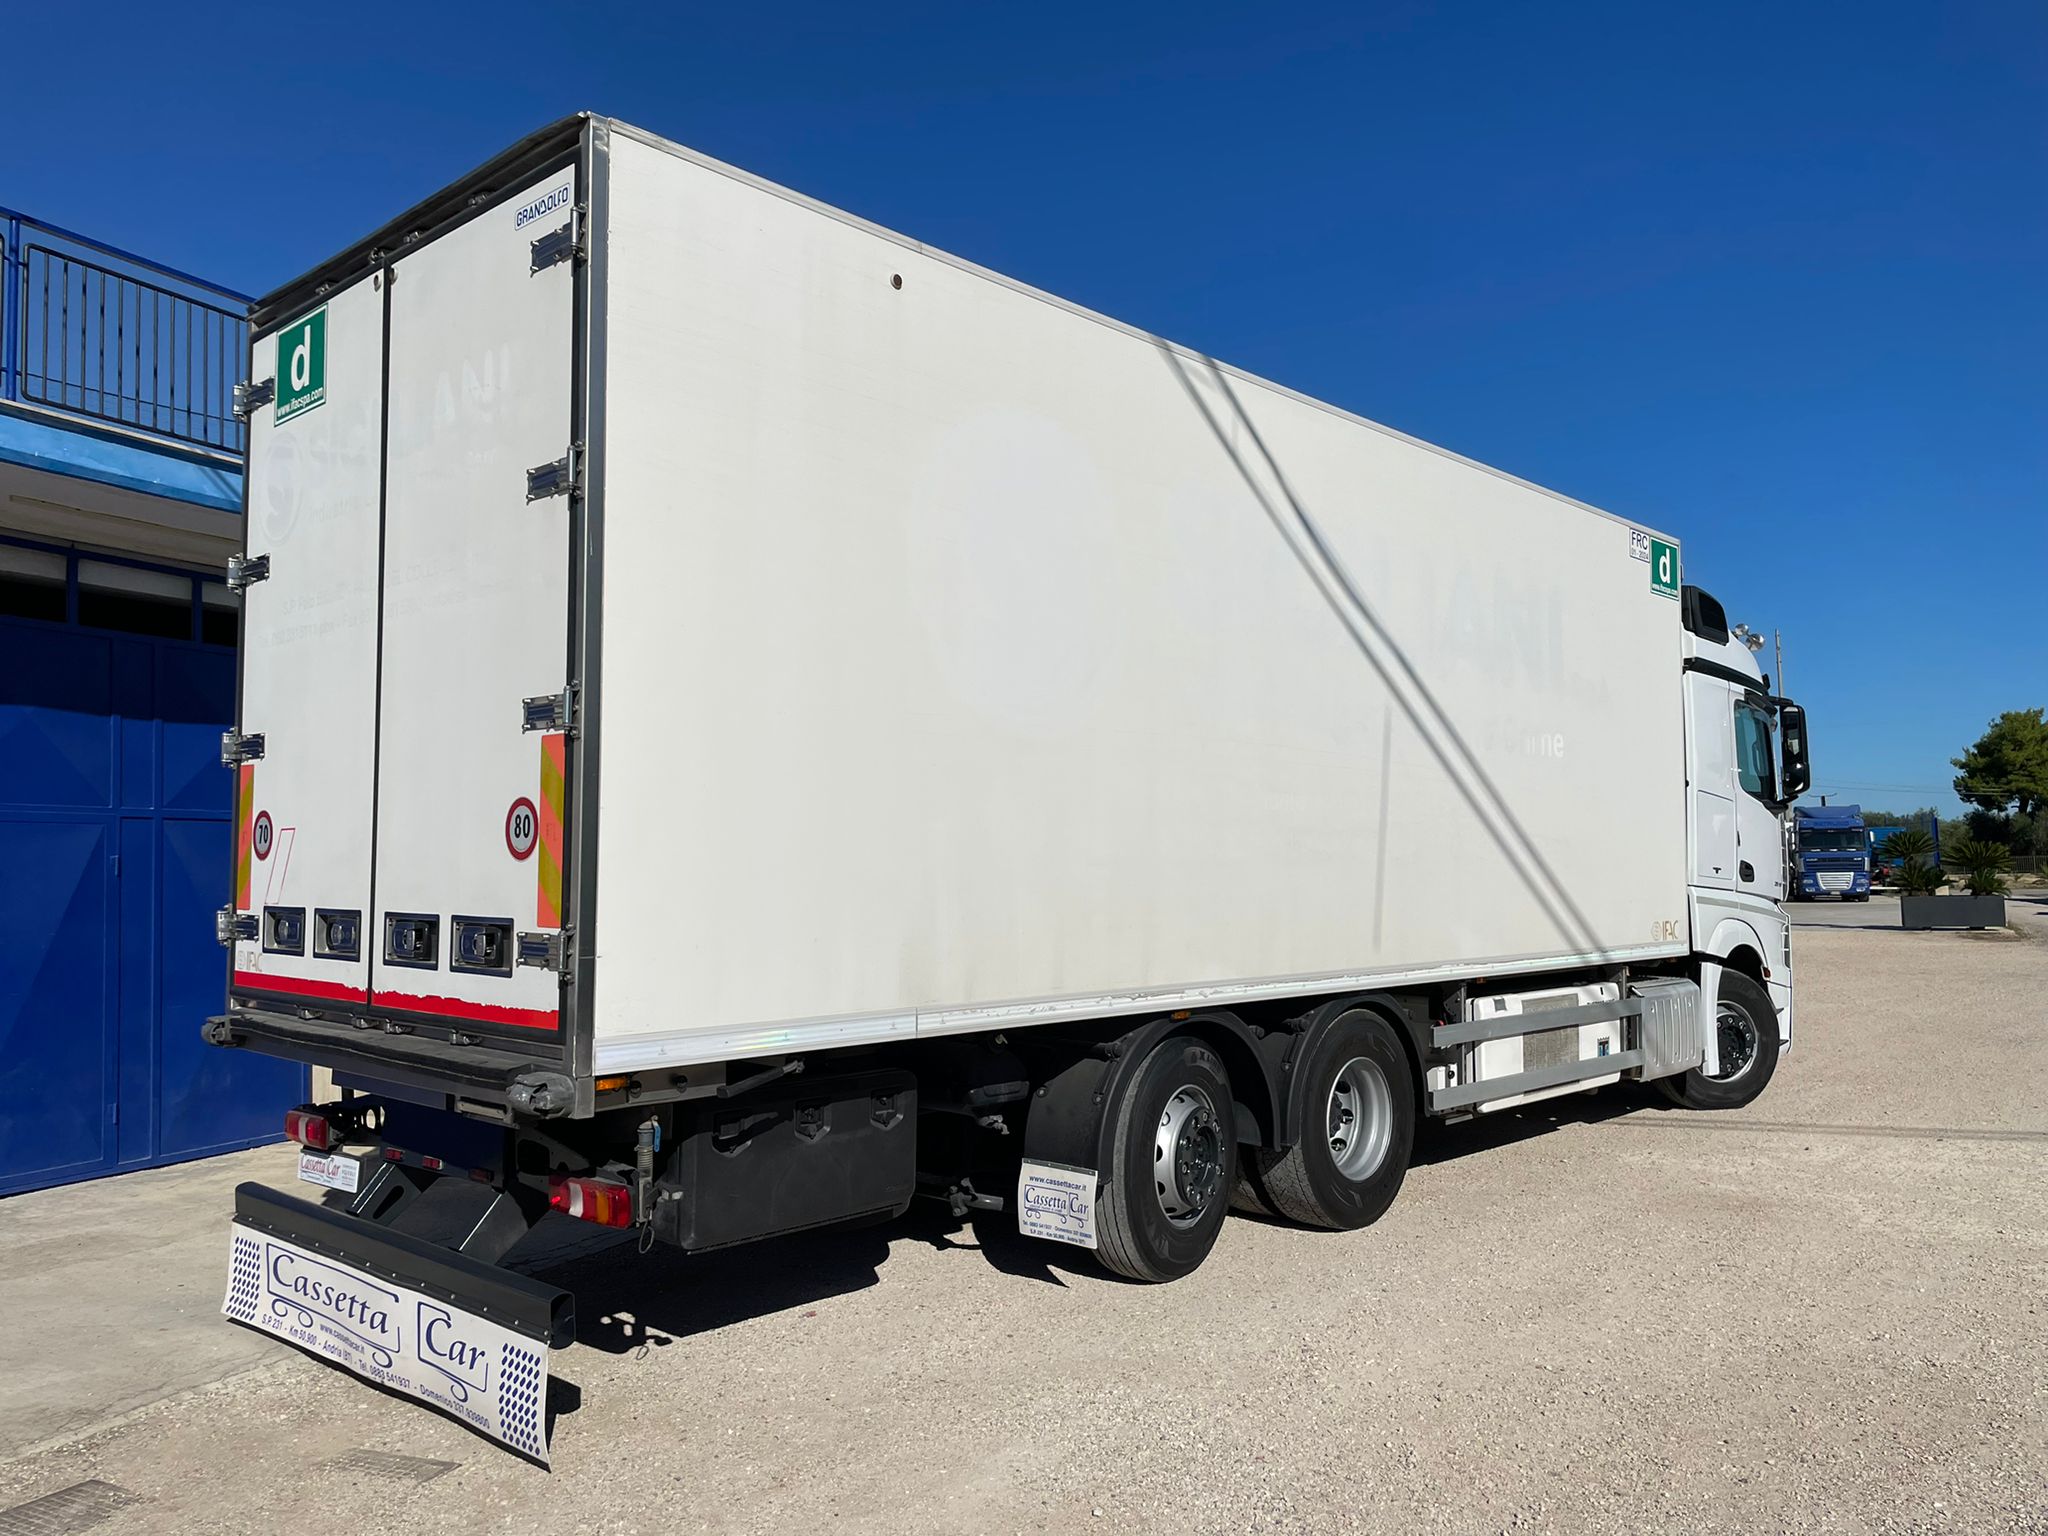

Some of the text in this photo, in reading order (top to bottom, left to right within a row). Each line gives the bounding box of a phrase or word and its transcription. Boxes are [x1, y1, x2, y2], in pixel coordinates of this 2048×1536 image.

[291, 324, 311, 392] d
[1631, 531, 1648, 550] FRC
[1659, 547, 1671, 584] d
[258, 824, 269, 845] 70
[514, 814, 531, 839] 80
[327, 1157, 341, 1178] Car
[1029, 1176, 1087, 1191] www.cassettacar.it
[1026, 1187, 1066, 1210] Cassetta
[1070, 1197, 1089, 1215] Car
[273, 1254, 486, 1370] Cassetta Car
[272, 1318, 283, 1331] 231
[288, 1325, 299, 1338] Km
[322, 1339, 342, 1358] Andria
